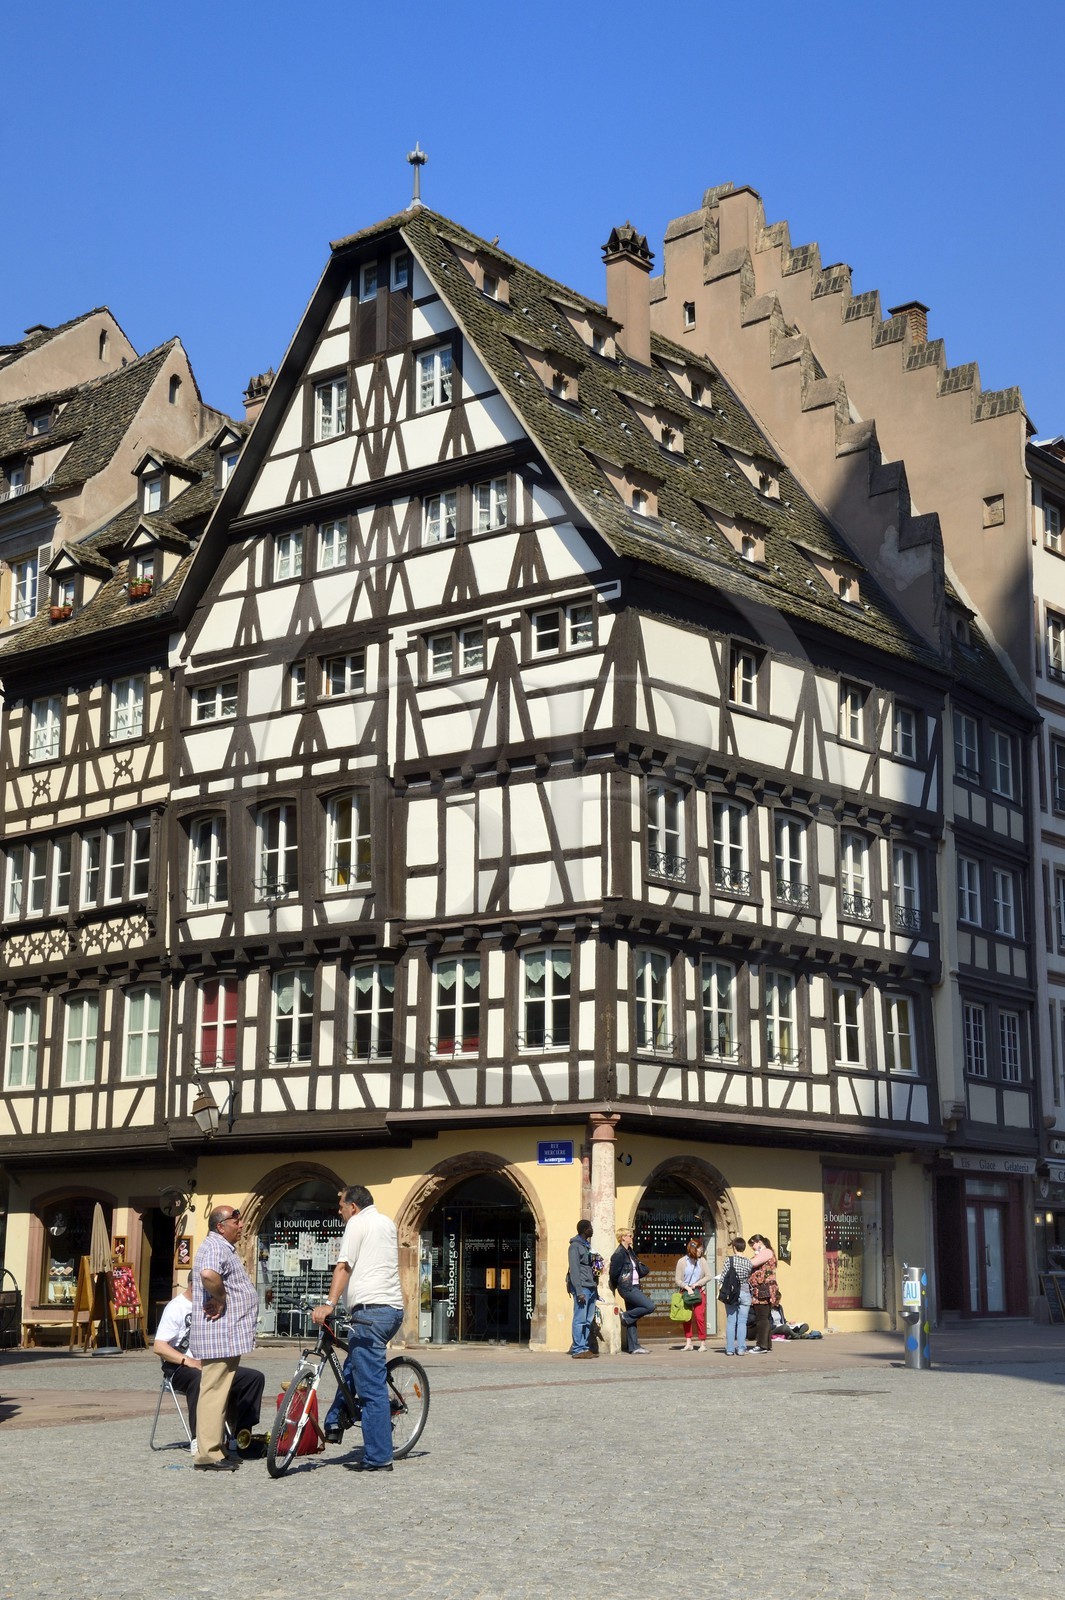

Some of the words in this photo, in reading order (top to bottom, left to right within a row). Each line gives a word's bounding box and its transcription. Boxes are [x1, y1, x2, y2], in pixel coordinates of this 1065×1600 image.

[961, 1157, 970, 1168] Eis
[979, 1159, 996, 1170] Glace
[1004, 1161, 1029, 1173] Gelateria
[274, 1218, 282, 1228] la
[283, 1218, 320, 1231] boutique
[829, 1210, 858, 1226] boutique
[446, 1233, 459, 1318] Strasbourg.eu
